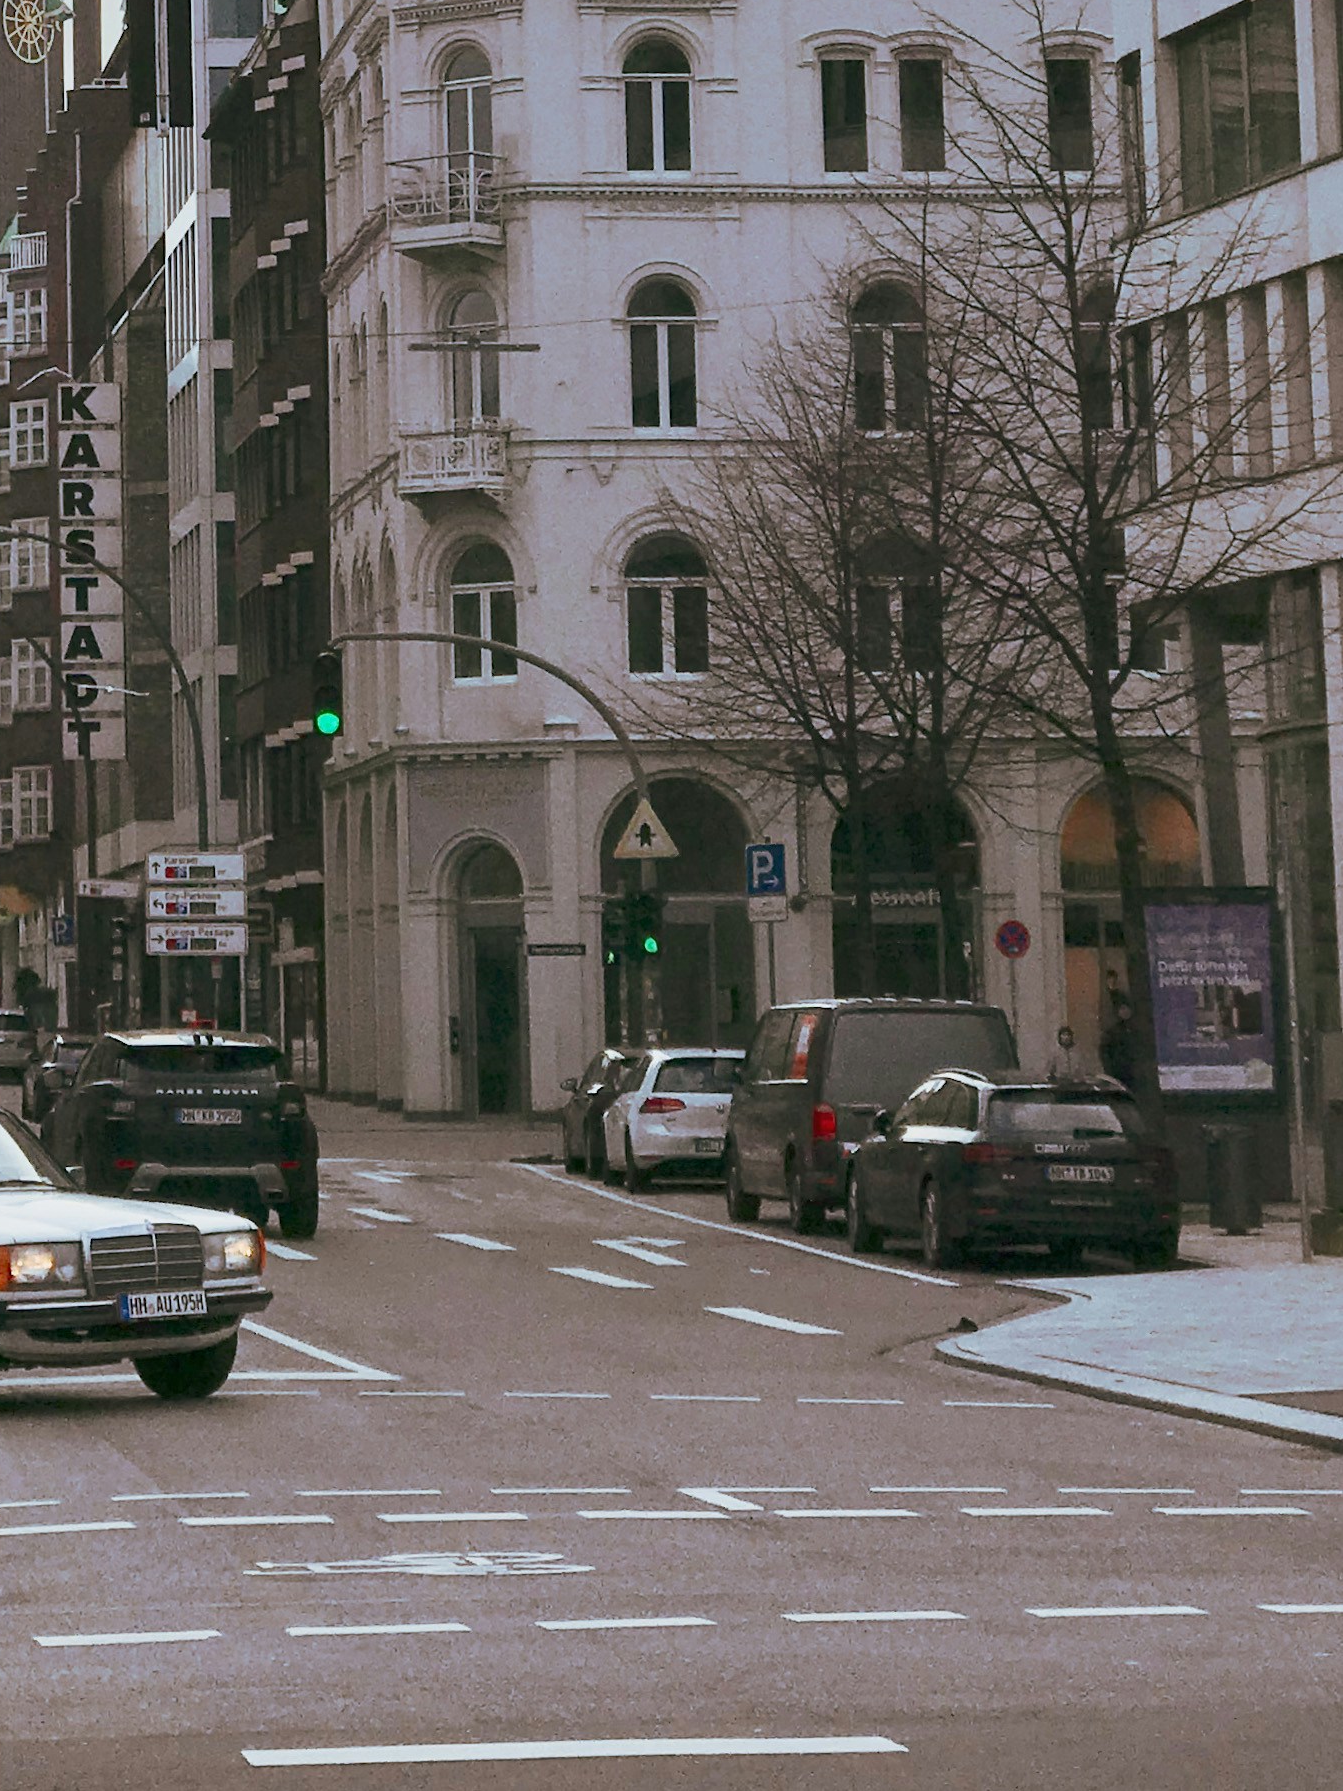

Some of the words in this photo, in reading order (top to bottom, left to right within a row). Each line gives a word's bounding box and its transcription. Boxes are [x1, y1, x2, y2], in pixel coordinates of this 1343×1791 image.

[60, 385, 104, 760] KARSTADT
[752, 850, 774, 889] P
[129, 1296, 148, 1316] HH
